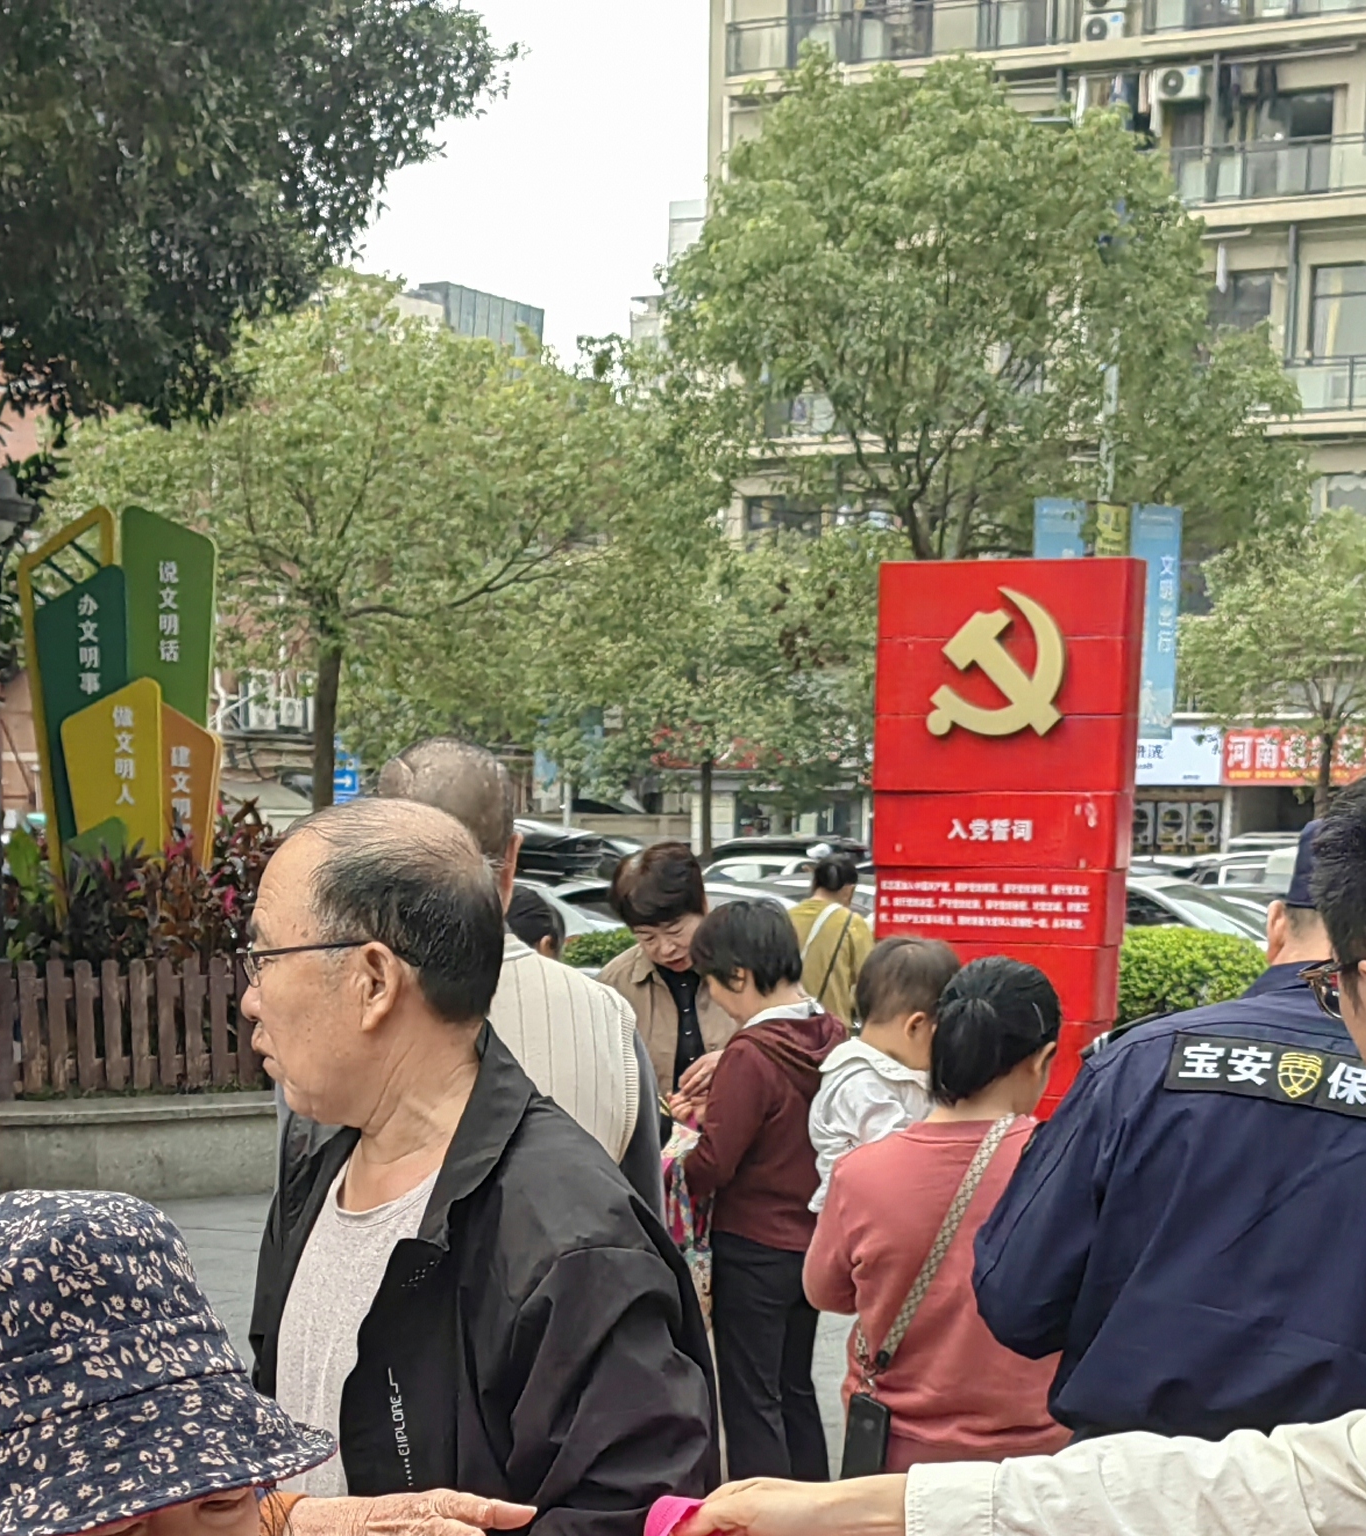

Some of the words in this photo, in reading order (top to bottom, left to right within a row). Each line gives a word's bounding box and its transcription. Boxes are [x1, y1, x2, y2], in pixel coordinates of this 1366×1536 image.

[77, 593, 101, 696] 办文明事
[158, 560, 180, 663] 说文明话
[112, 705, 136, 807] 做文明人
[170, 746, 191, 842] 建文明
[947, 818, 1033, 842] 入党誓词
[1178, 1042, 1273, 1086] 宝安
